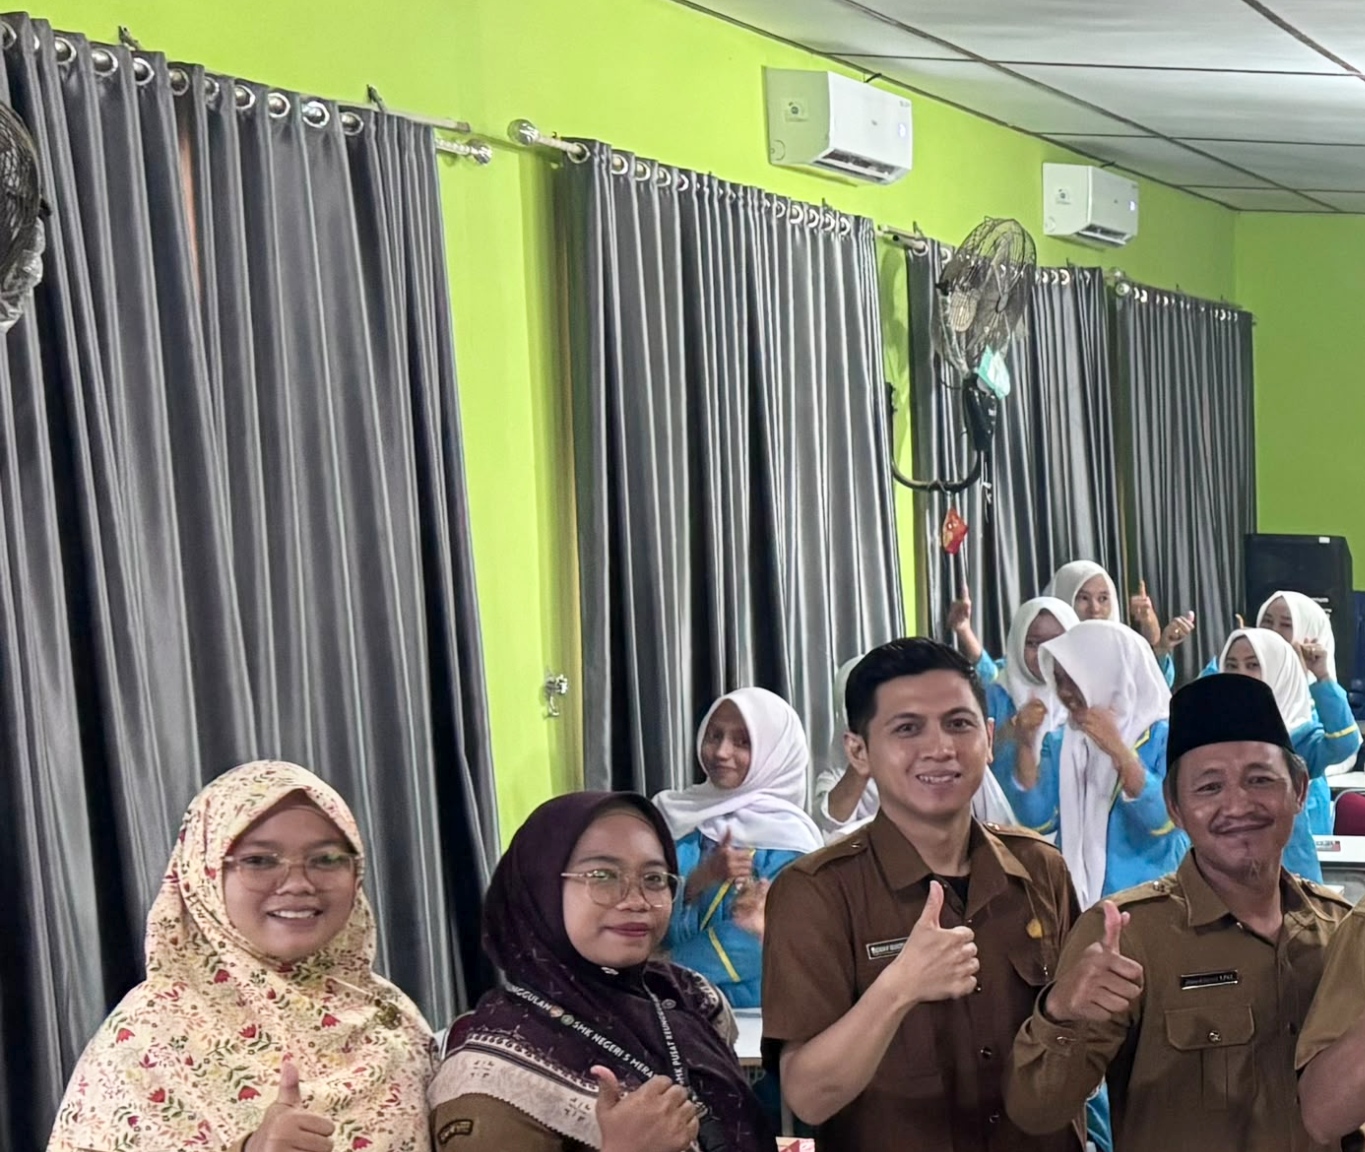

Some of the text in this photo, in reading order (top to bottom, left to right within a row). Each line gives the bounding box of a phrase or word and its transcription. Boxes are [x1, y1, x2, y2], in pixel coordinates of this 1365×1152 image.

[572, 1020, 592, 1038] SMK
[592, 1032, 625, 1057] NEGERI
[629, 1058, 657, 1079] MERA
[667, 1041, 682, 1066] PUSAT
